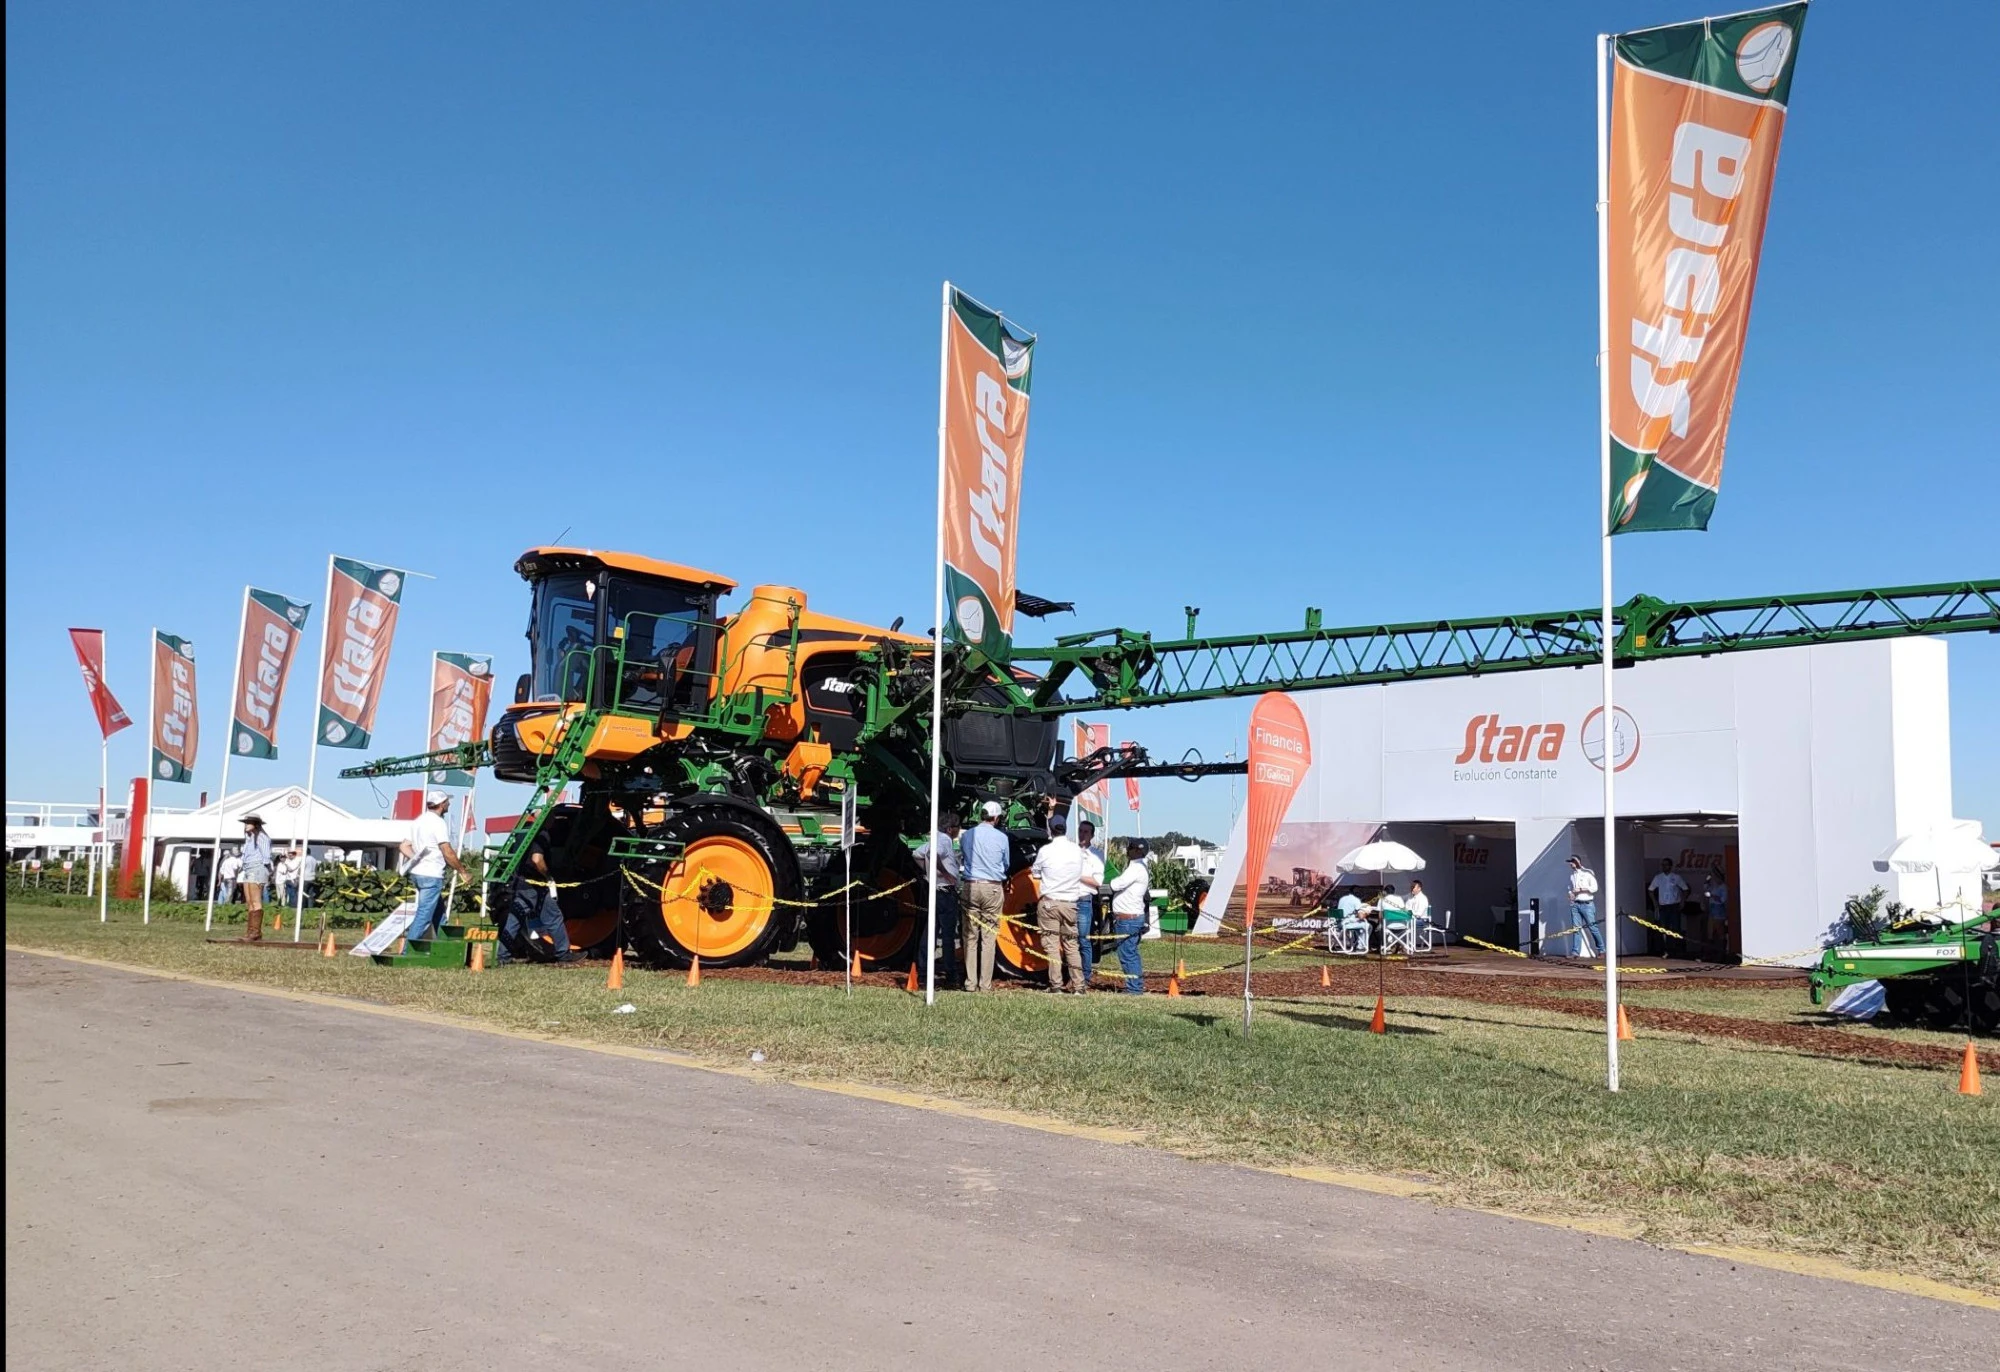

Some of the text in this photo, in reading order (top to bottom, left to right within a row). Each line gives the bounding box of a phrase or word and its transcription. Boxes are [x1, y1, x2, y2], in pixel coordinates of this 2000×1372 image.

[1631, 121, 1752, 440] Stara
[968, 371, 1008, 597] Stara
[246, 622, 290, 728] Stara
[333, 597, 383, 713] Stara
[162, 660, 193, 753] Stara
[1454, 714, 1566, 765] Stara
[1266, 769, 1291, 784] Galicia
[1453, 767, 1558, 782] Evolución Constante
[1675, 848, 1724, 869] Stara
[464, 927, 499, 941] Stara
